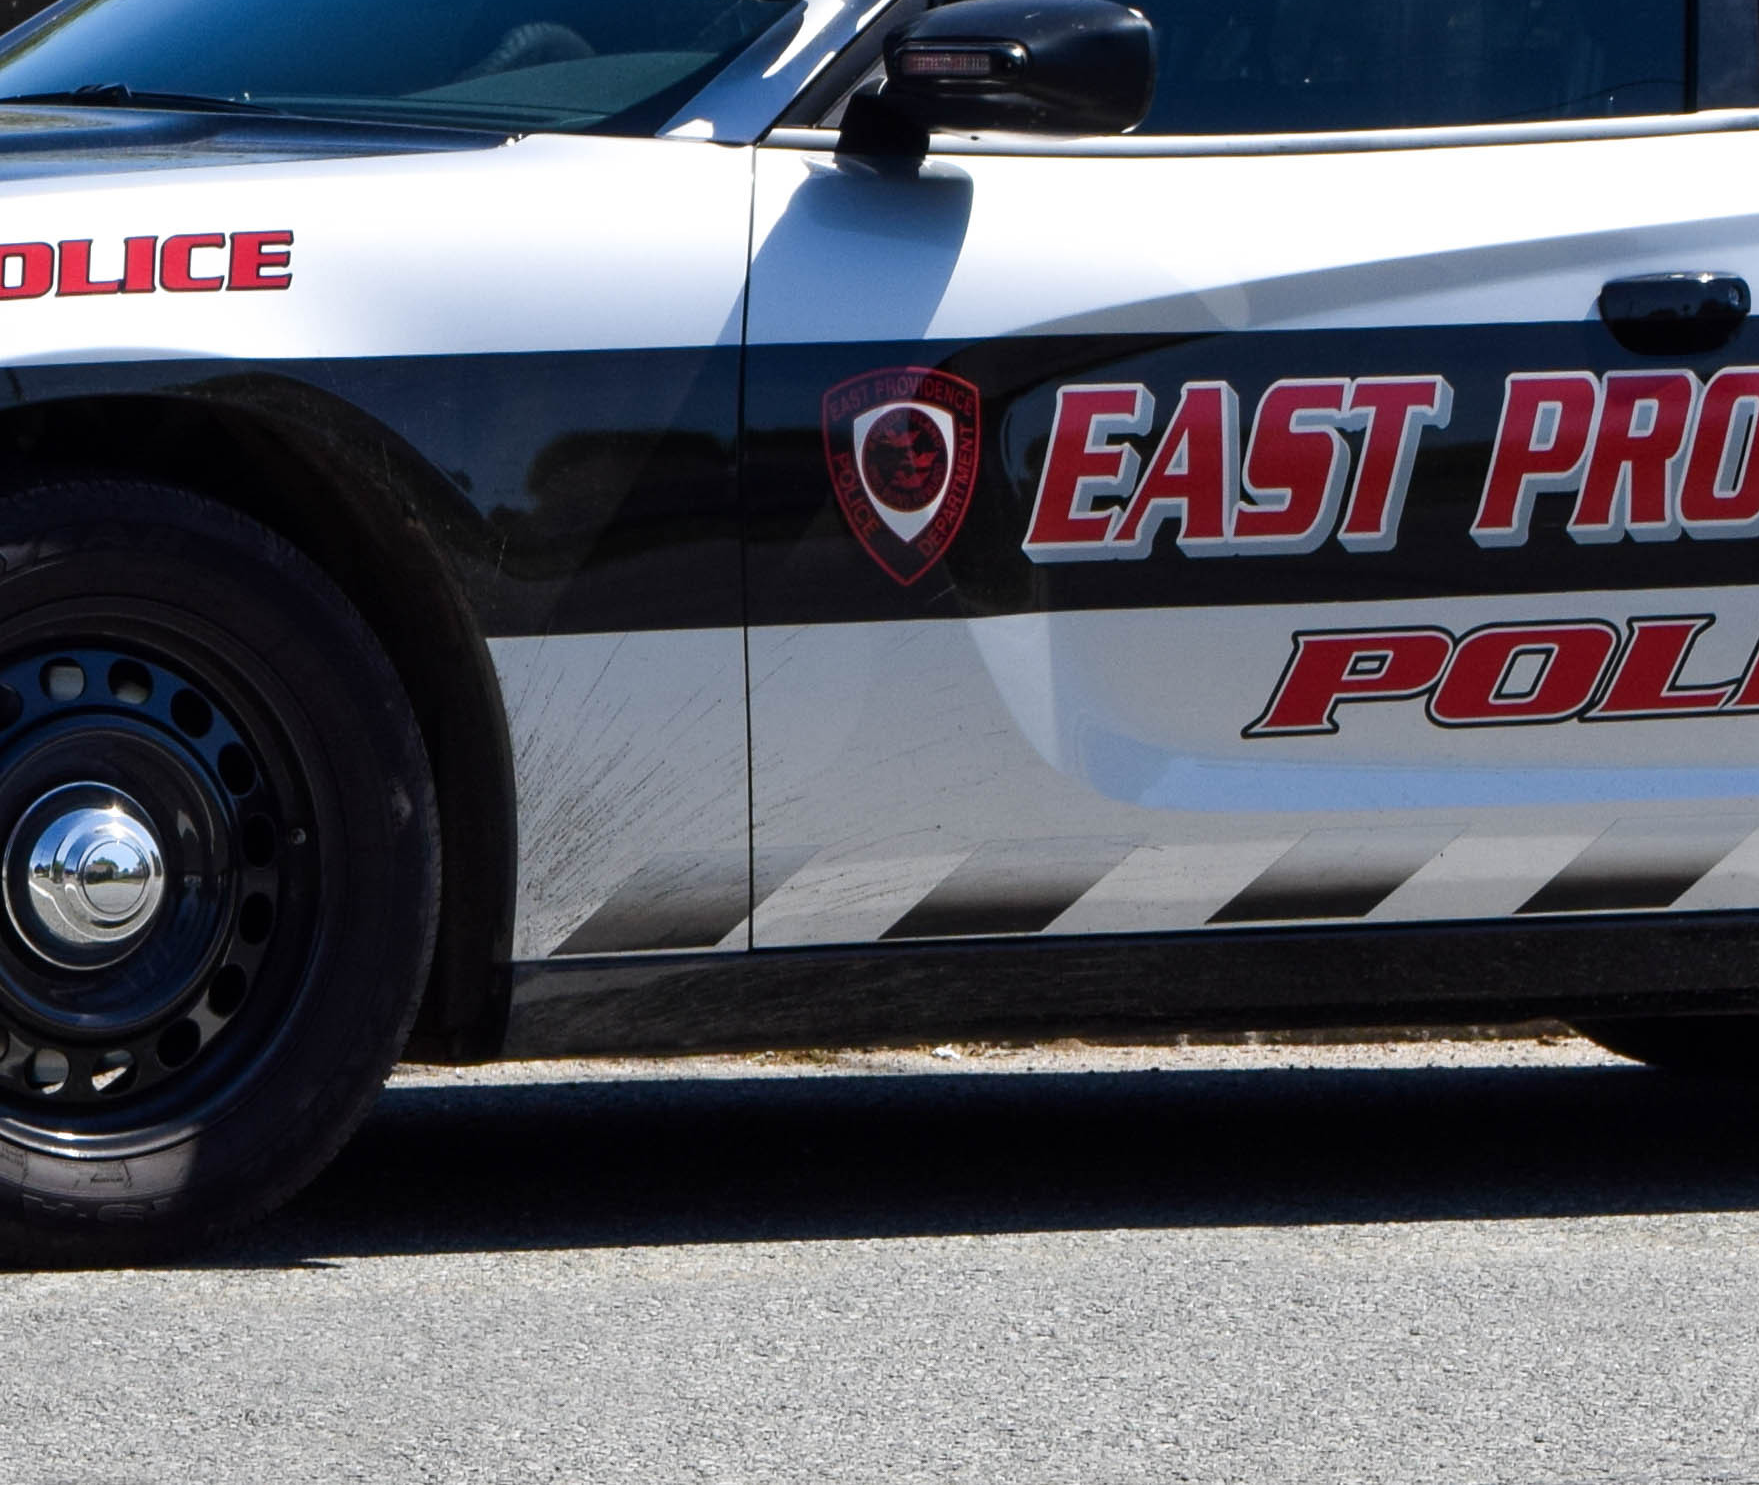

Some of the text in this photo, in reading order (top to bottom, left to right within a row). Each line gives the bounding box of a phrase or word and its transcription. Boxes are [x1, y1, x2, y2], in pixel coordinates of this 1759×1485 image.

[830, 377, 975, 421] EAST PROVIDENCE
[834, 452, 881, 538] POLICE
[918, 427, 975, 556] DEPARTMENT
[1021, 374, 1454, 564] EAST
